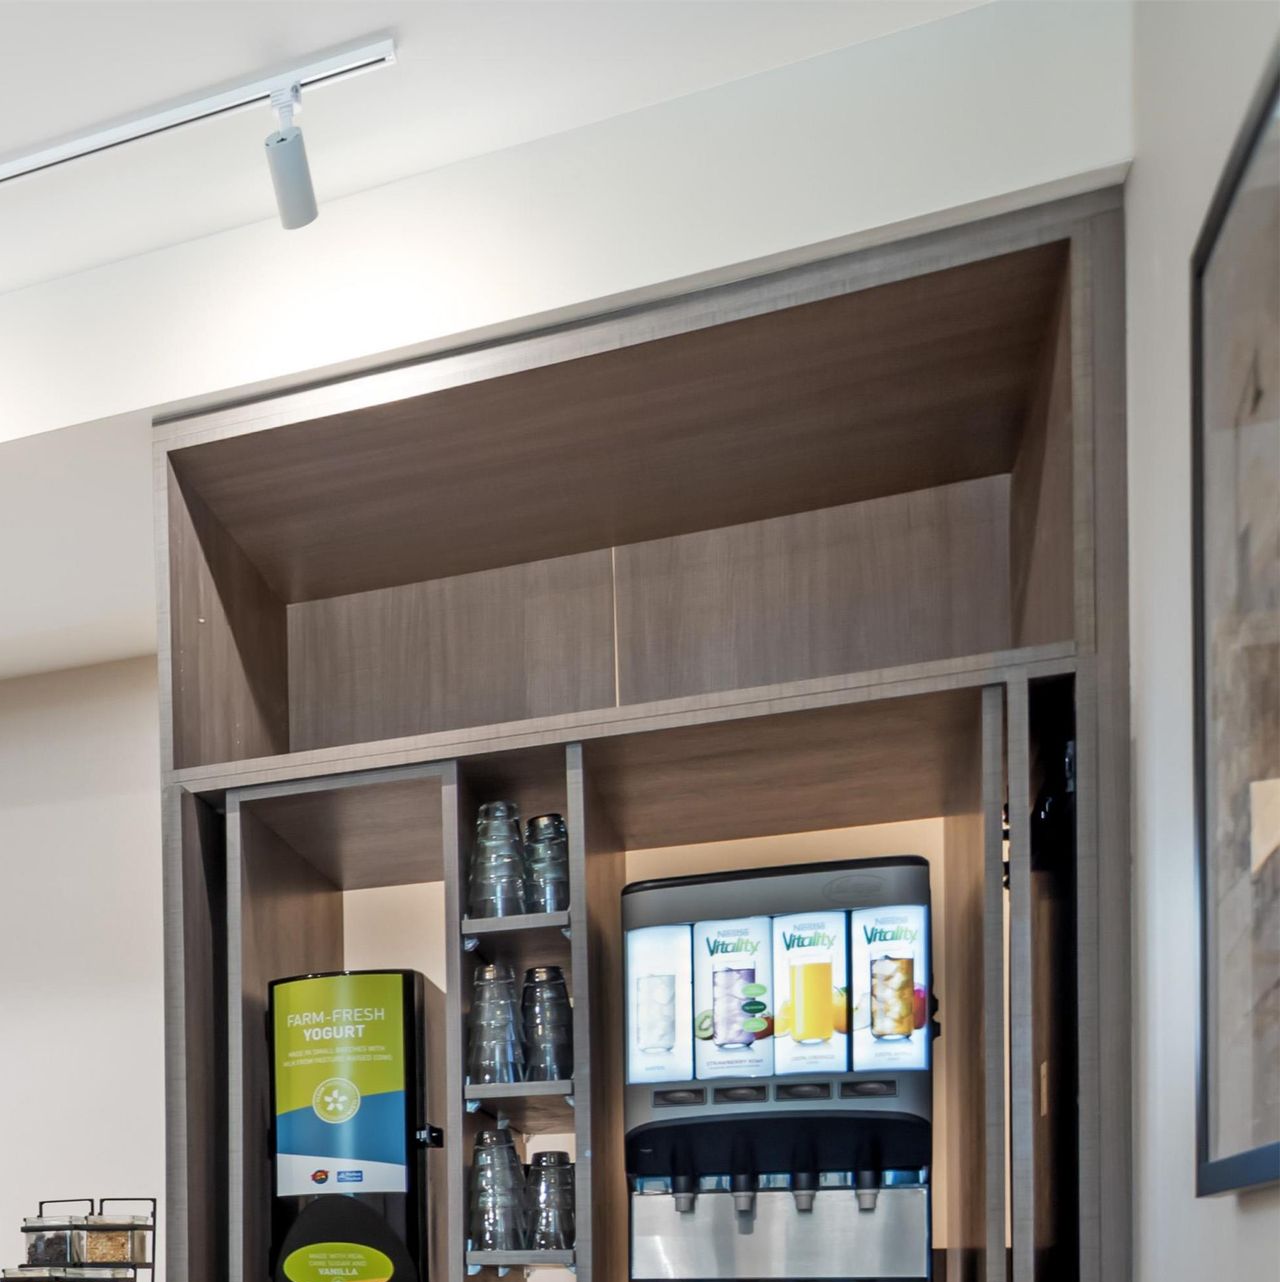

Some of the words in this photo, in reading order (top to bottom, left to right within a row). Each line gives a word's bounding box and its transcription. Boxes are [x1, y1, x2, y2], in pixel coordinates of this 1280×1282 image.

[705, 936, 761, 957] Vitality
[782, 931, 837, 951] Vitality
[287, 1008, 384, 1027] FARM-FRESH
[304, 1025, 365, 1041] YOGURT
[318, 1267, 358, 1275] VANILLA
